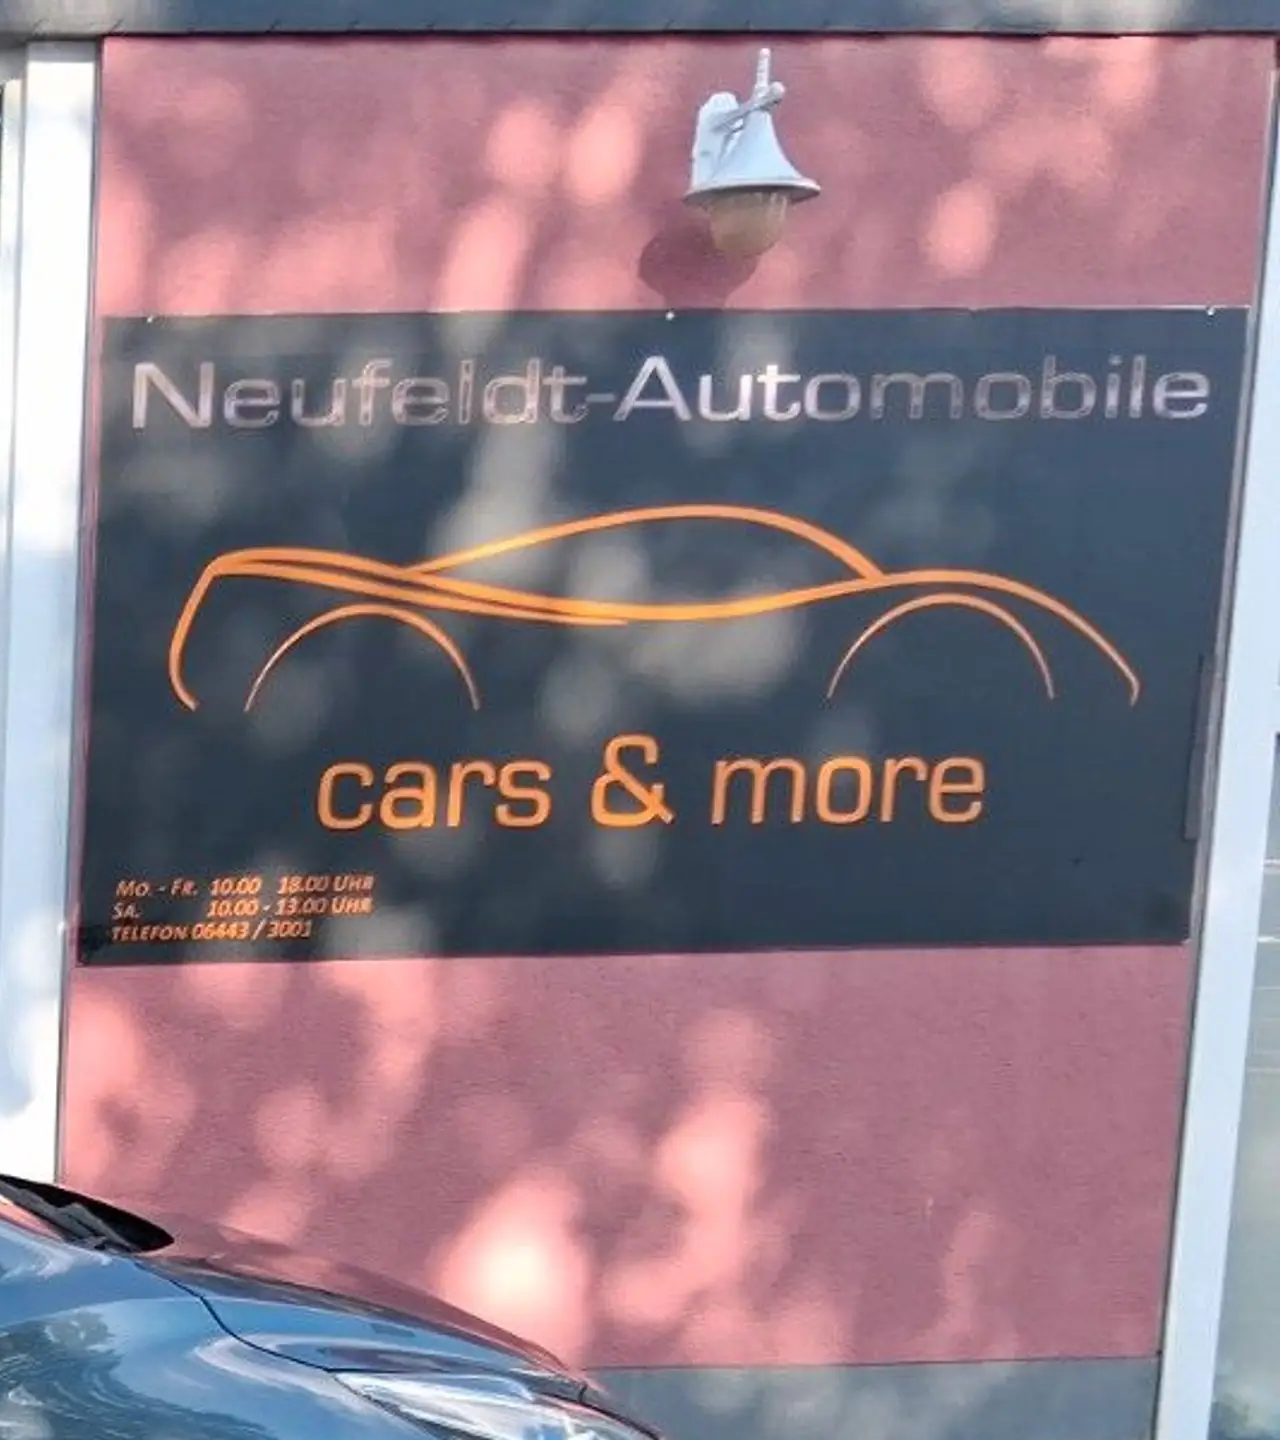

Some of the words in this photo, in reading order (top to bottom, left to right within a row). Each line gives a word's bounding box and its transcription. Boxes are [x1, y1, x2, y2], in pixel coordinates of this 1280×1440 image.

[132, 354, 1210, 430] Neufeldt-Automobile
[317, 755, 552, 832] cars
[590, 734, 674, 828] &
[710, 750, 987, 828] more
[210, 877, 262, 897] 10.00
[207, 899, 259, 918] 10.00
[111, 925, 188, 942] TELEFON
[267, 921, 311, 938] 3001
